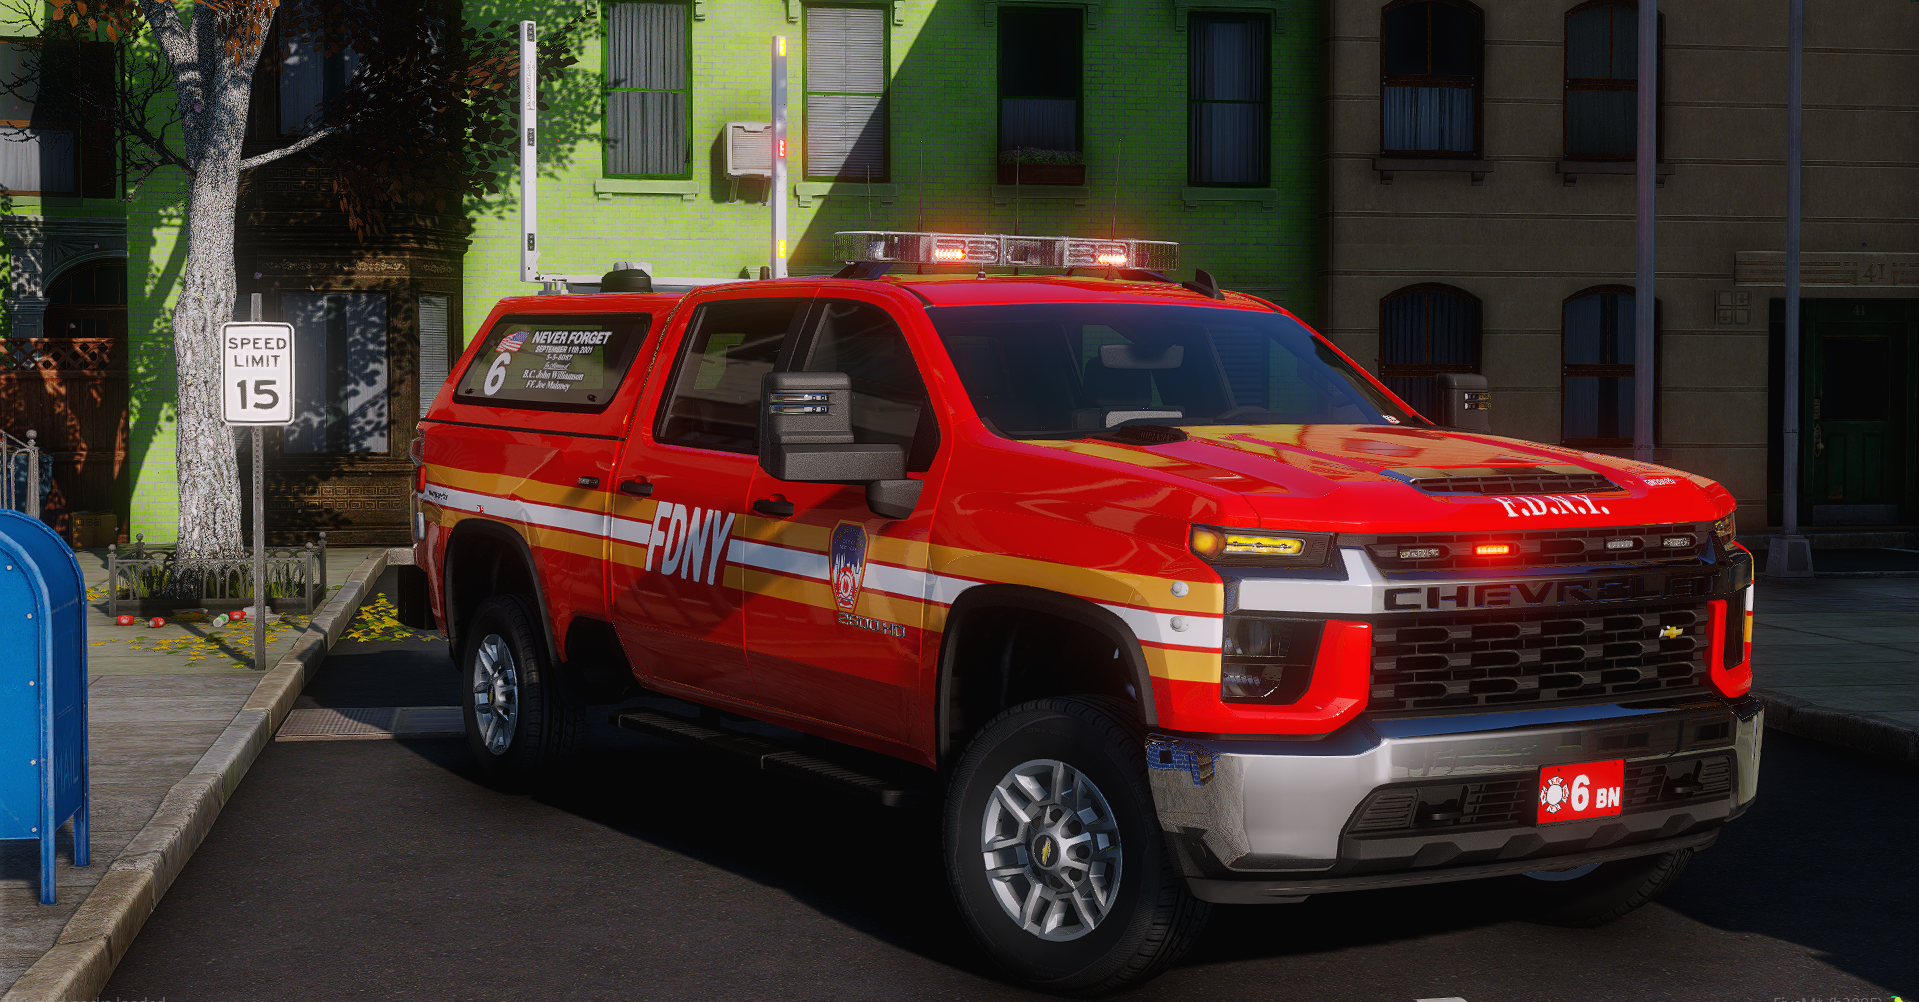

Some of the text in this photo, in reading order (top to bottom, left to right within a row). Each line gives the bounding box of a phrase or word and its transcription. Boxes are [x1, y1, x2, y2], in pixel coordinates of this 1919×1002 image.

[1863, 263, 1885, 283] 41
[1852, 304, 1866, 316] 41
[228, 337, 287, 350] SPEED
[531, 331, 613, 345] NEVER FORGET
[535, 345, 568, 353] SEPTEMBER
[579, 346, 594, 354] 2001
[234, 355, 280, 367] LIMIT
[483, 352, 511, 396] 6
[535, 380, 547, 389] Joe
[536, 370, 551, 379] John
[236, 379, 280, 410] 15
[1491, 495, 1610, 517] F.D.N.Y.
[645, 500, 736, 586] FDNY
[1384, 574, 1718, 611] CHEVROLET
[838, 612, 906, 638] 2500 HD
[55, 742, 79, 800] MAIL
[1570, 774, 1590, 811] 6
[1595, 786, 1621, 809] BN
